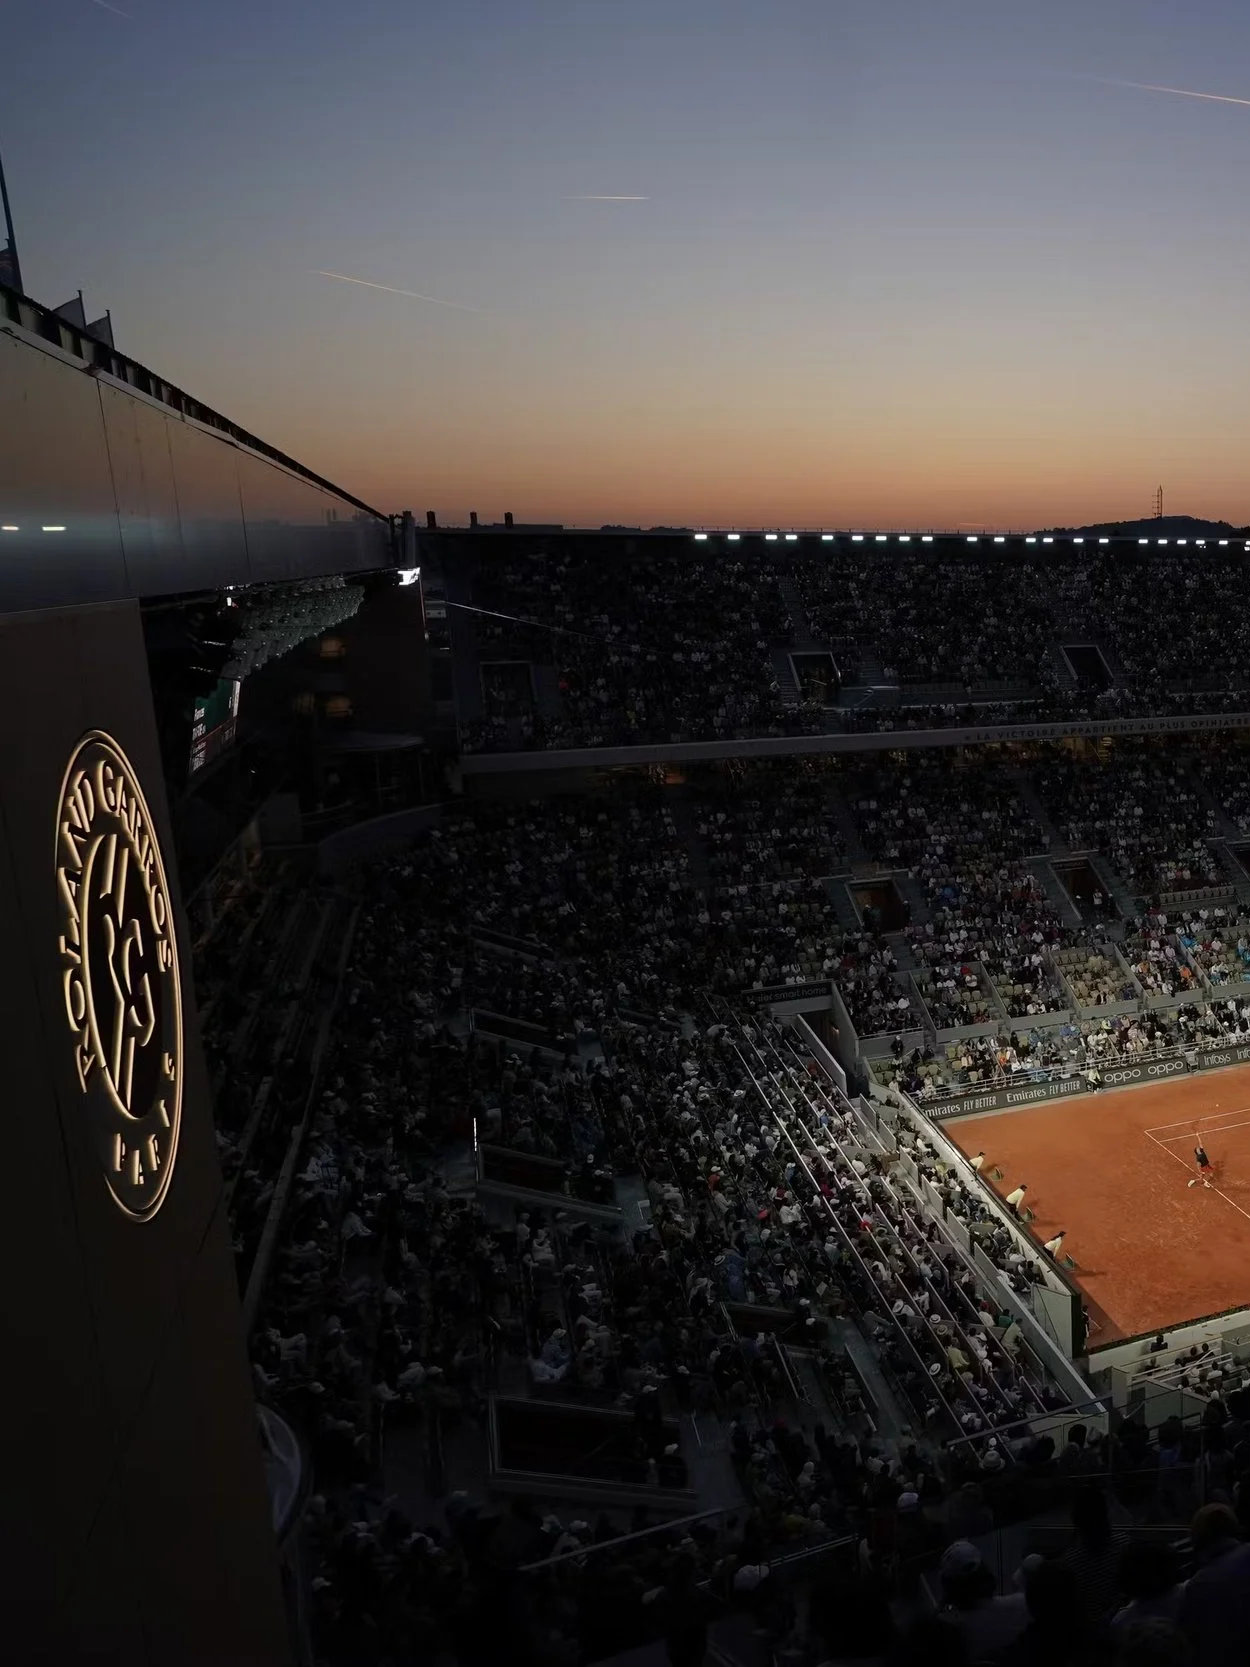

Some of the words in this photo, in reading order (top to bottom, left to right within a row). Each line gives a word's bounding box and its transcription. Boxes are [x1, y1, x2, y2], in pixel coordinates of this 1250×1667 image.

[1204, 1053, 1232, 1066] Infosys
[1104, 1068, 1141, 1084] oppo
[1148, 1061, 1184, 1076] oppo
[1007, 1088, 1046, 1103] Emirates
[1049, 1083, 1059, 1096] FLY
[1060, 1080, 1081, 1094] BETTER
[963, 1100, 975, 1111] FLY
[975, 1096, 997, 1109] BETTER
